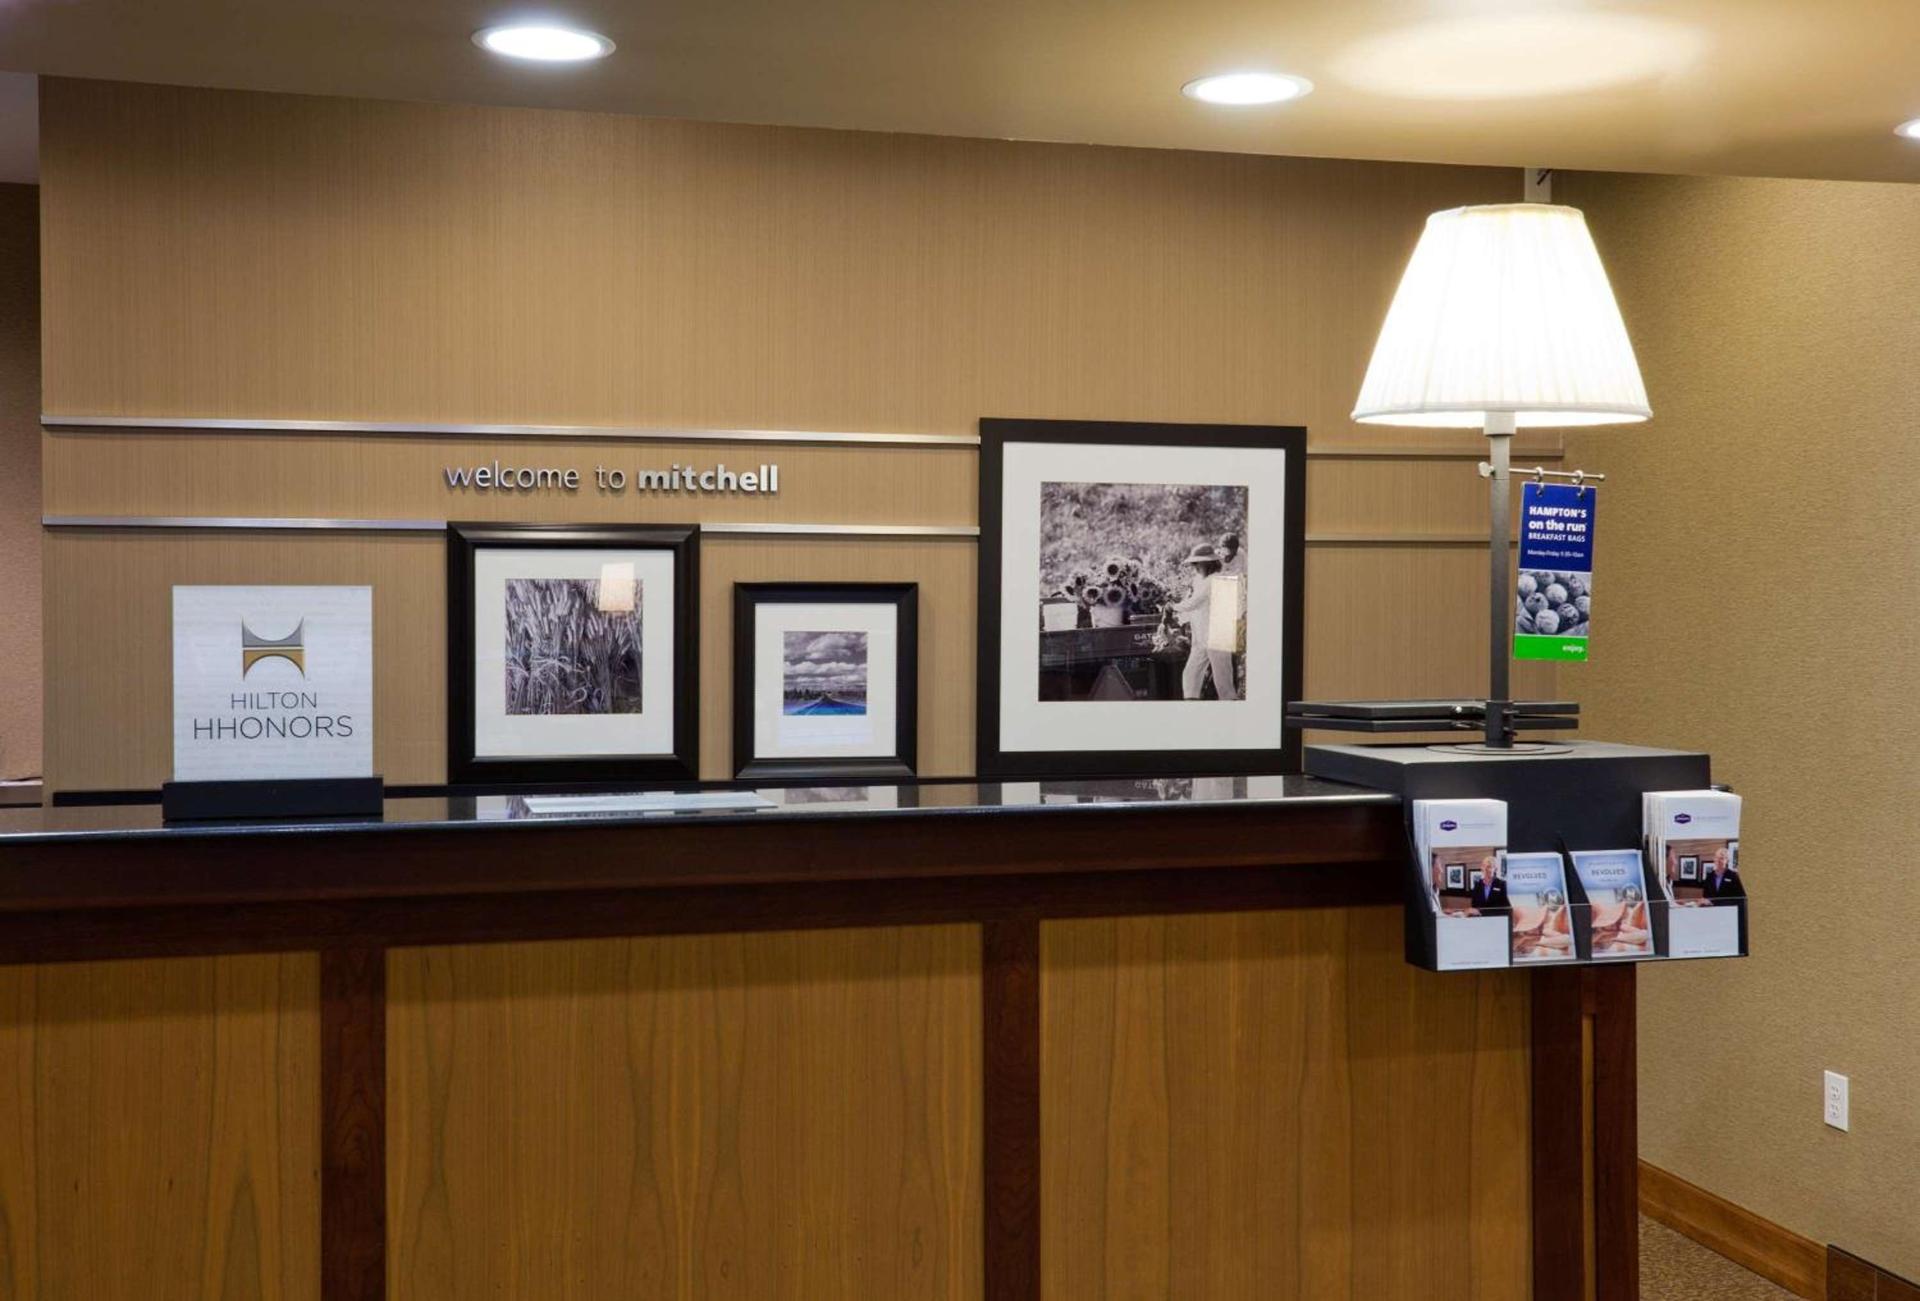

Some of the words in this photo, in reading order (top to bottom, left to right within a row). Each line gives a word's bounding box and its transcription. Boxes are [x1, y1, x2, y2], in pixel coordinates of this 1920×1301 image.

[444, 460, 580, 489] welcome
[595, 464, 626, 489] to
[638, 464, 778, 492] mitchell
[1529, 506, 1587, 518] HAMPTON'S
[1528, 520, 1544, 530] on
[1546, 519, 1565, 531] the
[1566, 522, 1586, 533] run
[1528, 532, 1566, 542] BREAKFAST
[1567, 534, 1586, 543] BAGS
[231, 691, 318, 710] HILTON
[193, 715, 354, 740] HHONORS
